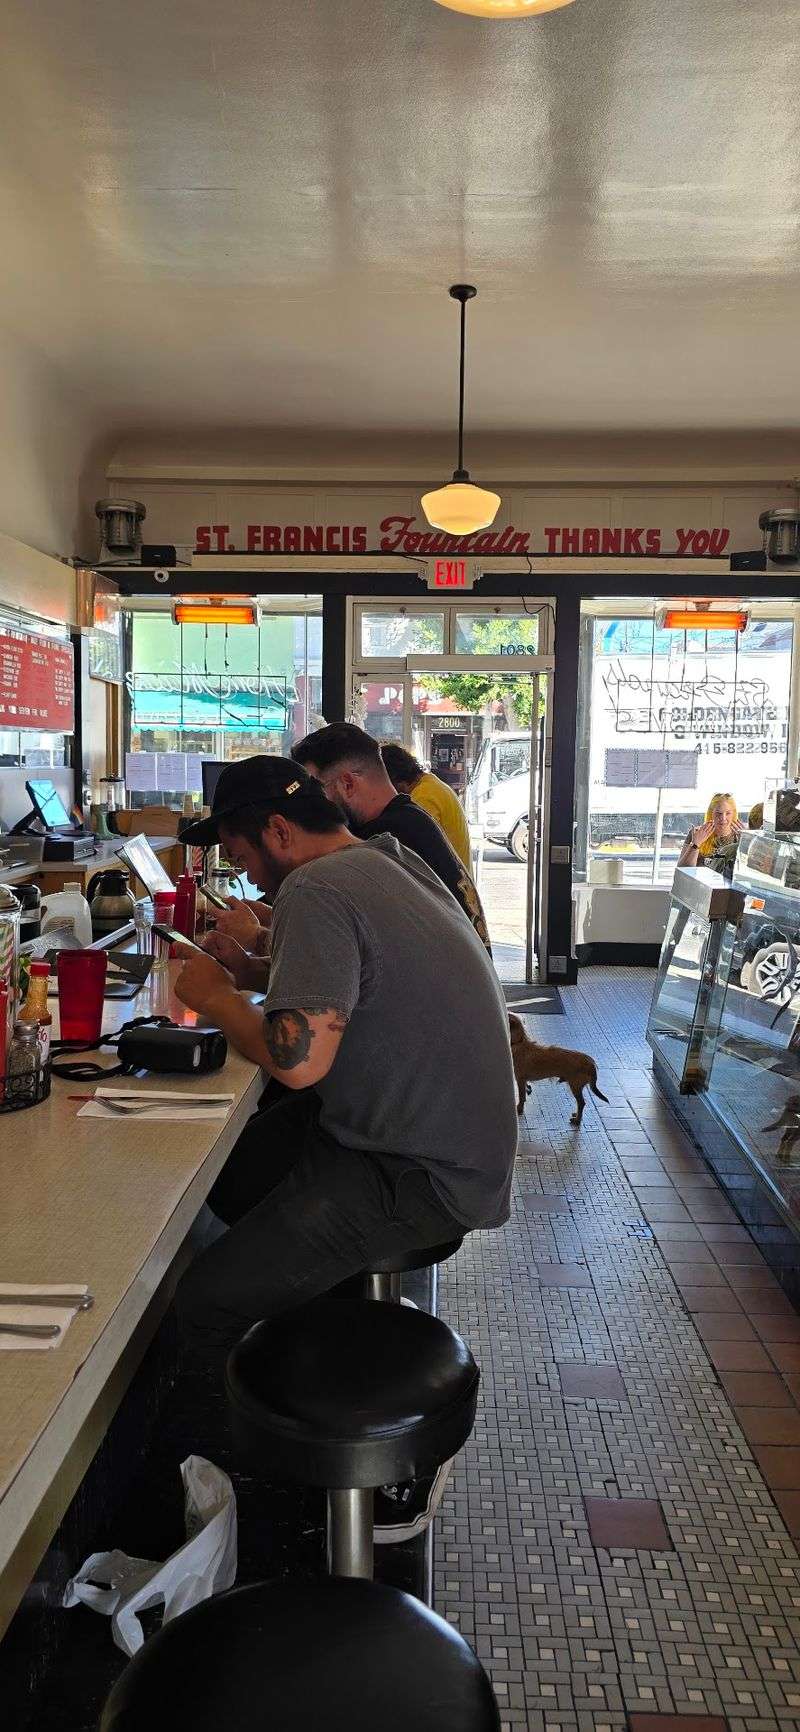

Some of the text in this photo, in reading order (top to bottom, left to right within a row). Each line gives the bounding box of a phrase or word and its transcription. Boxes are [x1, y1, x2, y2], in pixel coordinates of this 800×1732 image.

[195, 515, 731, 556] ST. FRANCIS Fountain THANKS YOU
[434, 559, 467, 587] EXIT
[437, 716, 461, 729] 2800
